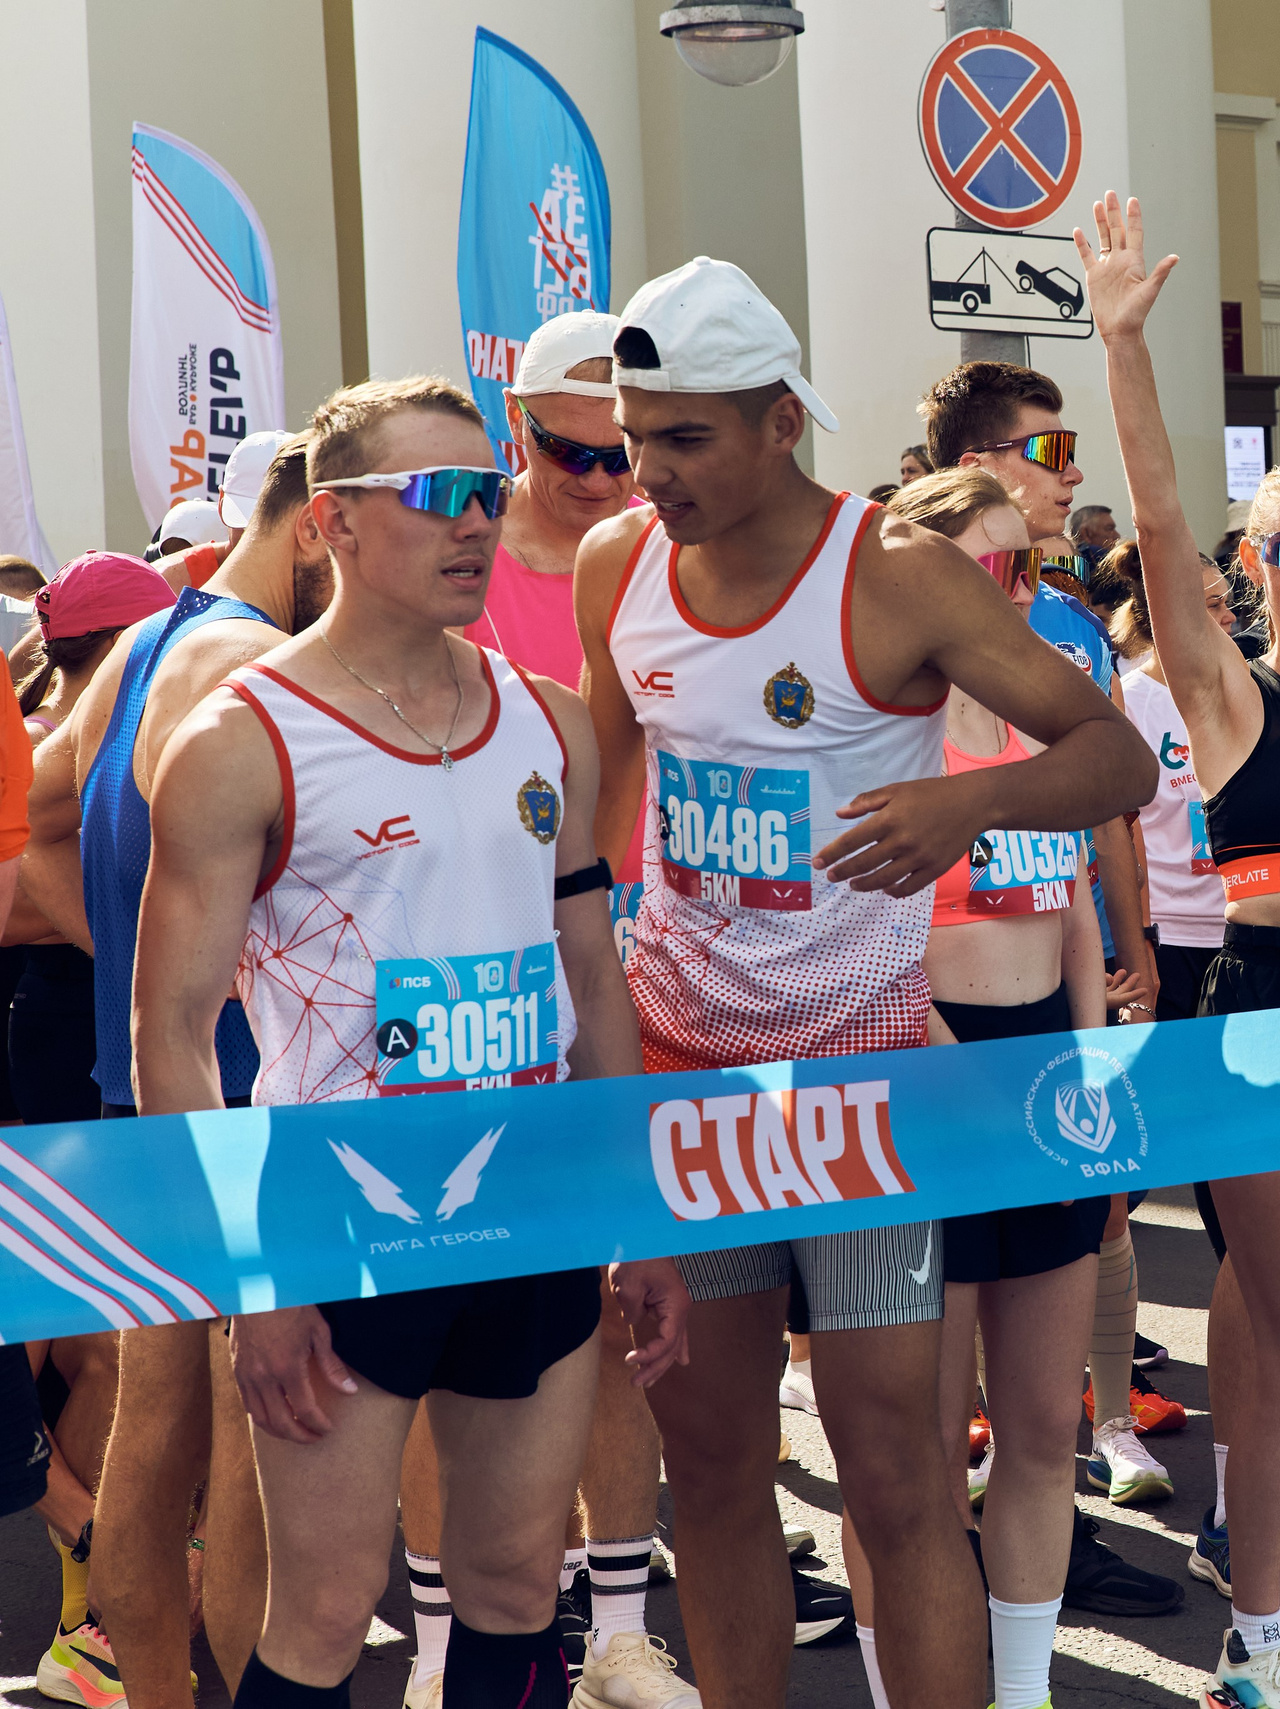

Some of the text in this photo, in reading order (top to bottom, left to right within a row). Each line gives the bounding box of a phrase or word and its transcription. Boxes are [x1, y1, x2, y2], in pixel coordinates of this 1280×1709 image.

[632, 670, 674, 691] VC
[706, 770, 732, 798] 10
[353, 815, 415, 847] VC
[668, 795, 789, 876] 30486
[984, 829, 1078, 886] 30325
[403, 977, 431, 988] ПСБ
[473, 960, 504, 993] 10
[416, 991, 539, 1078] 30511
[1023, 1046, 1149, 1166] ВСЕРОССИЙСКАЯ ФЕДЕРАЦИЯ ЛЕГКОЙ АТЛЕТИКИ
[649, 1080, 905, 1221] СТАРТ
[1080, 1157, 1141, 1178] ВФЛА
[370, 1227, 511, 1255] ЛИГА ГЕРОЕВ
